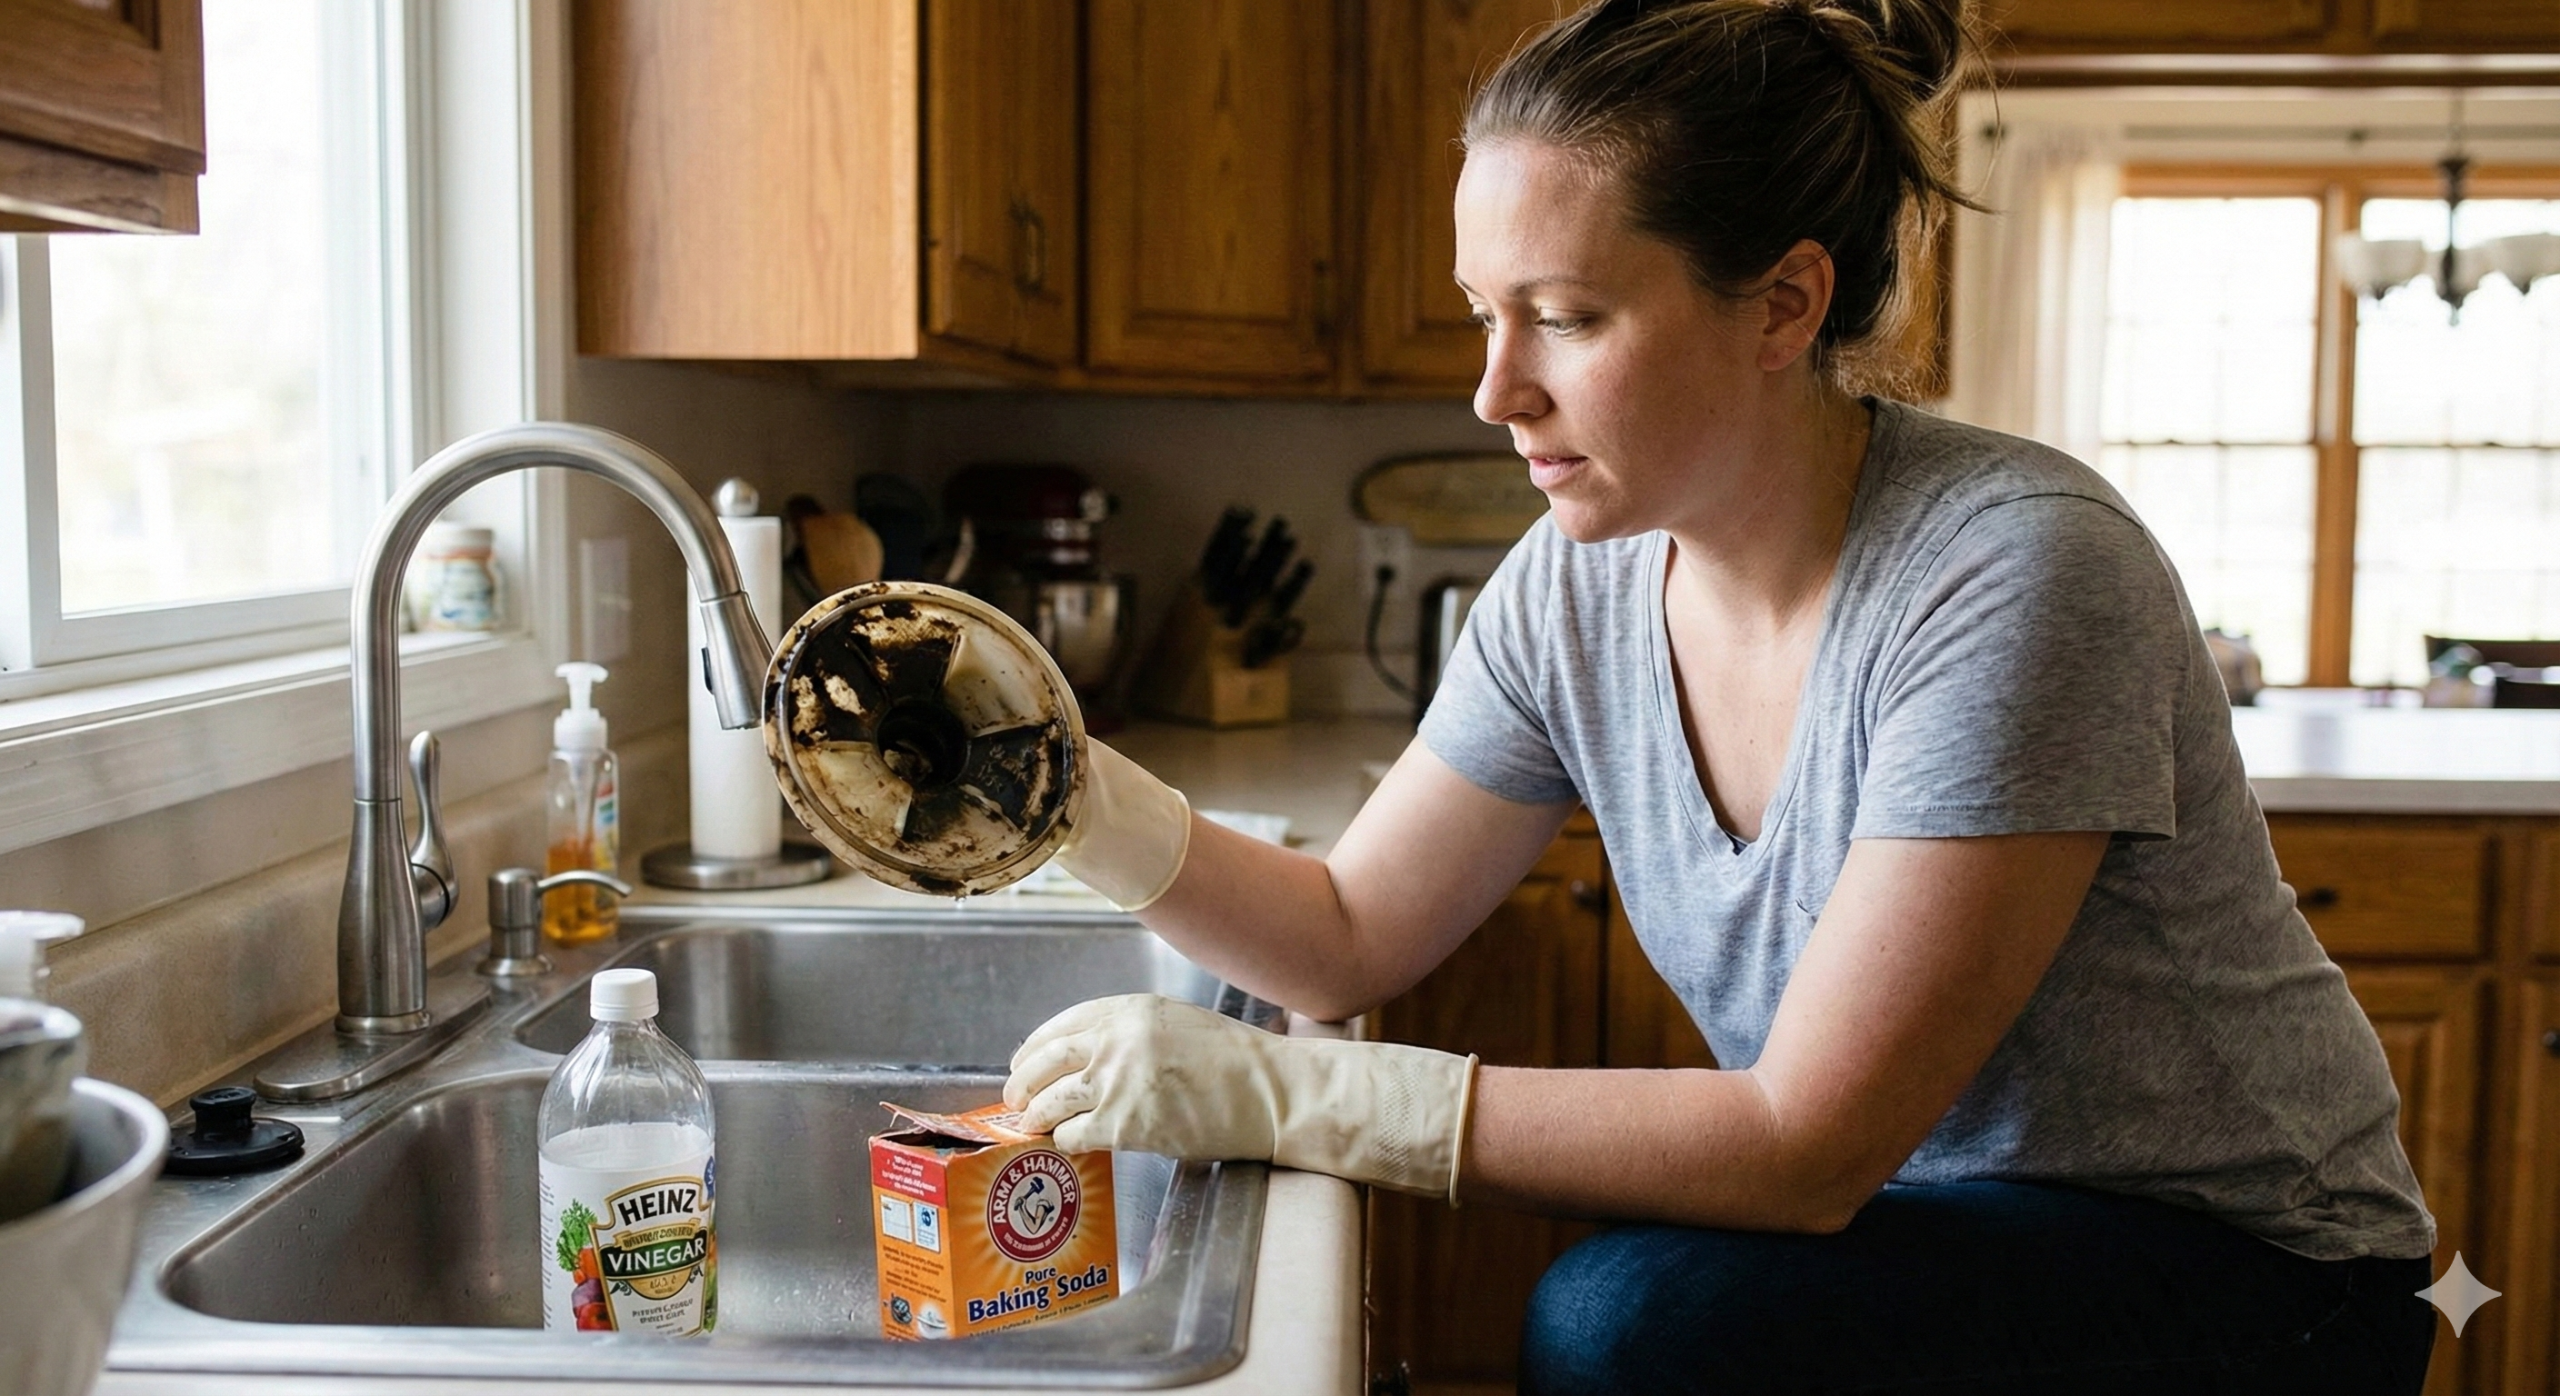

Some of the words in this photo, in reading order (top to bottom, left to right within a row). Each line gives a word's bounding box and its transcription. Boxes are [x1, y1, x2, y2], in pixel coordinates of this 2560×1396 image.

[617, 1189, 696, 1226] HEINZ
[993, 1180, 1013, 1223] ARM
[1008, 1167, 1023, 1184] &
[1022, 1155, 1076, 1204] HAMMER
[608, 1237, 705, 1272] VINEGAR
[968, 1286, 1050, 1322] Baking
[1056, 1265, 1108, 1297] Soda
[1025, 1267, 1057, 1284] Pure
